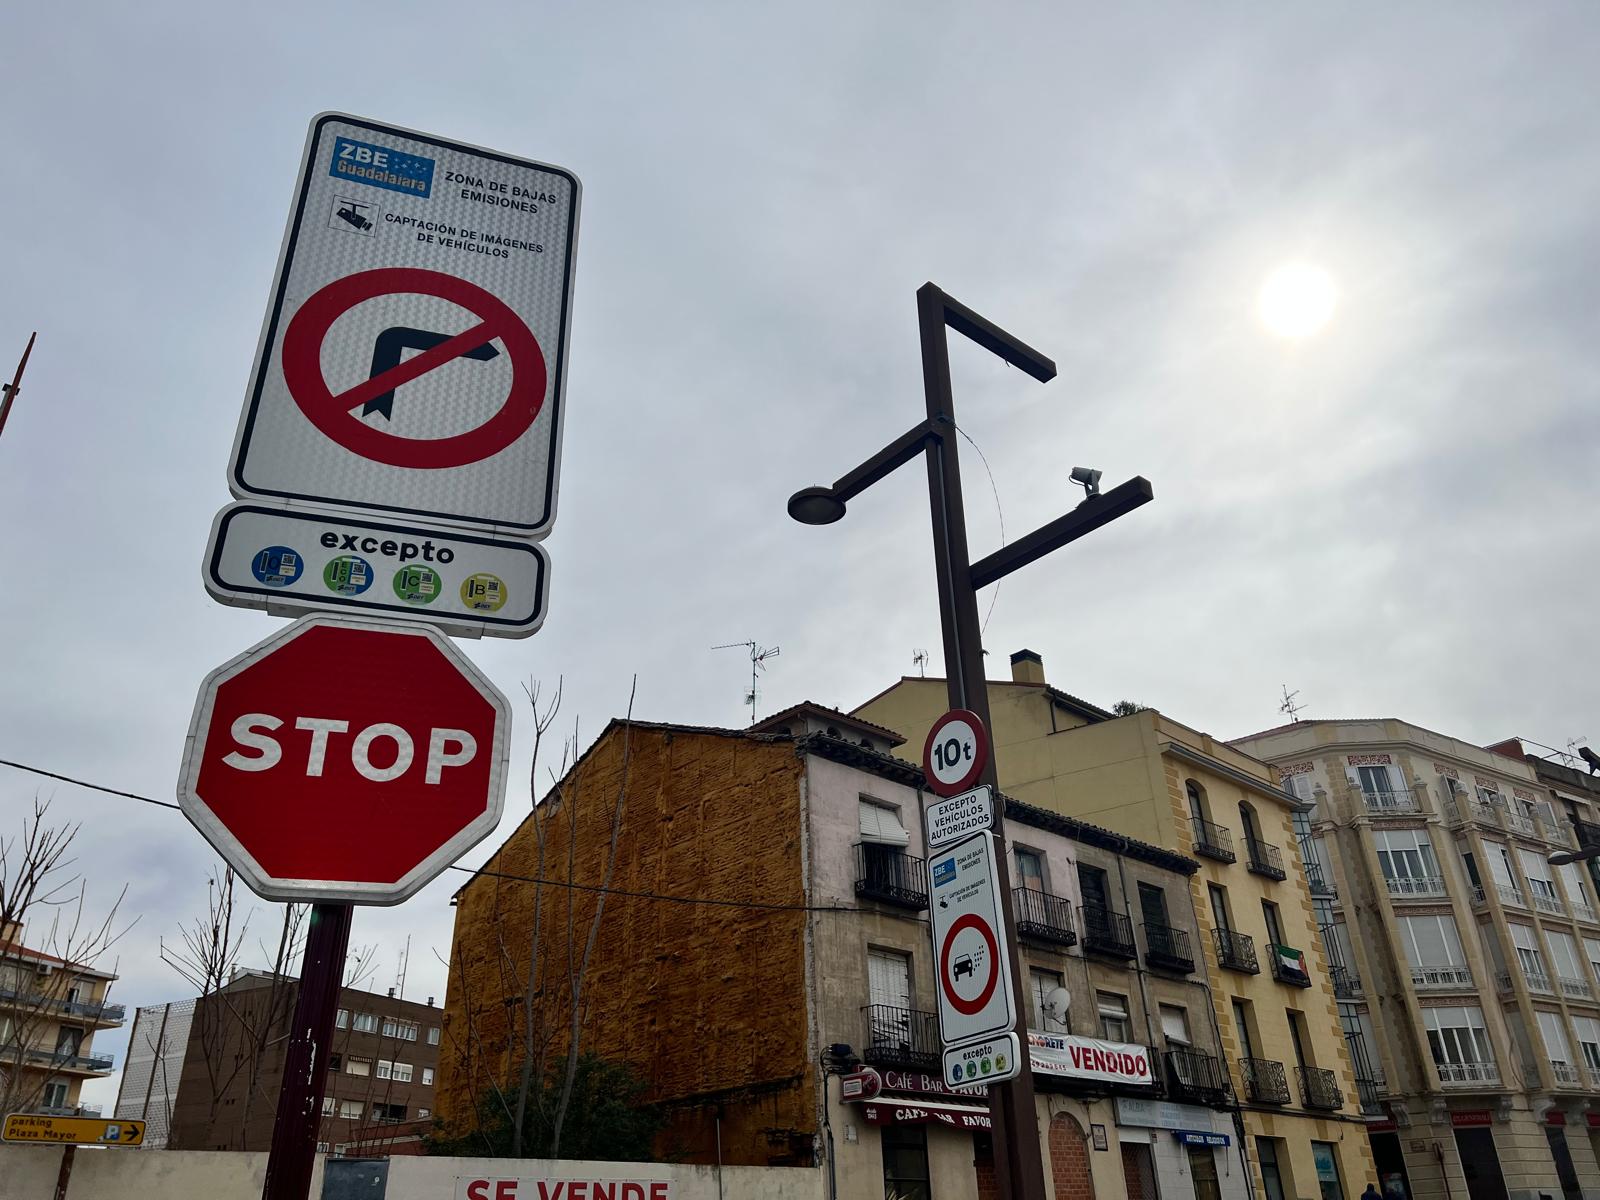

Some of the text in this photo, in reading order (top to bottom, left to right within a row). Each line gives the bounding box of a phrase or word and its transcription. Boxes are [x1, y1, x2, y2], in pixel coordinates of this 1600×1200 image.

[339, 142, 388, 168] ZBE
[445, 171, 557, 204] ZONA DE BAJAS
[460, 189, 538, 214] EMISIONES
[385, 212, 543, 253] CAPTACIÓN DE IMÁGENES
[417, 232, 509, 259] DE VEHÍCULOS
[320, 530, 455, 564] excepto
[408, 575, 420, 587] C
[475, 584, 486, 595] B
[221, 713, 477, 785] STOP
[938, 795, 977, 815] EXCEPTO
[931, 814, 990, 840] AUTORIZADOS
[957, 857, 967, 866] ZONA
[972, 848, 984, 858] BAJAS
[934, 864, 946, 877] ZBE
[962, 1045, 993, 1060] excepto
[1068, 1046, 1147, 1076] VENDIDO
[11, 1118, 52, 1128] parking
[962, 1115, 992, 1128] FAVOR
[9, 1129, 77, 1140] Plaza Mayor
[467, 1180, 668, 1200] SE VENDE
